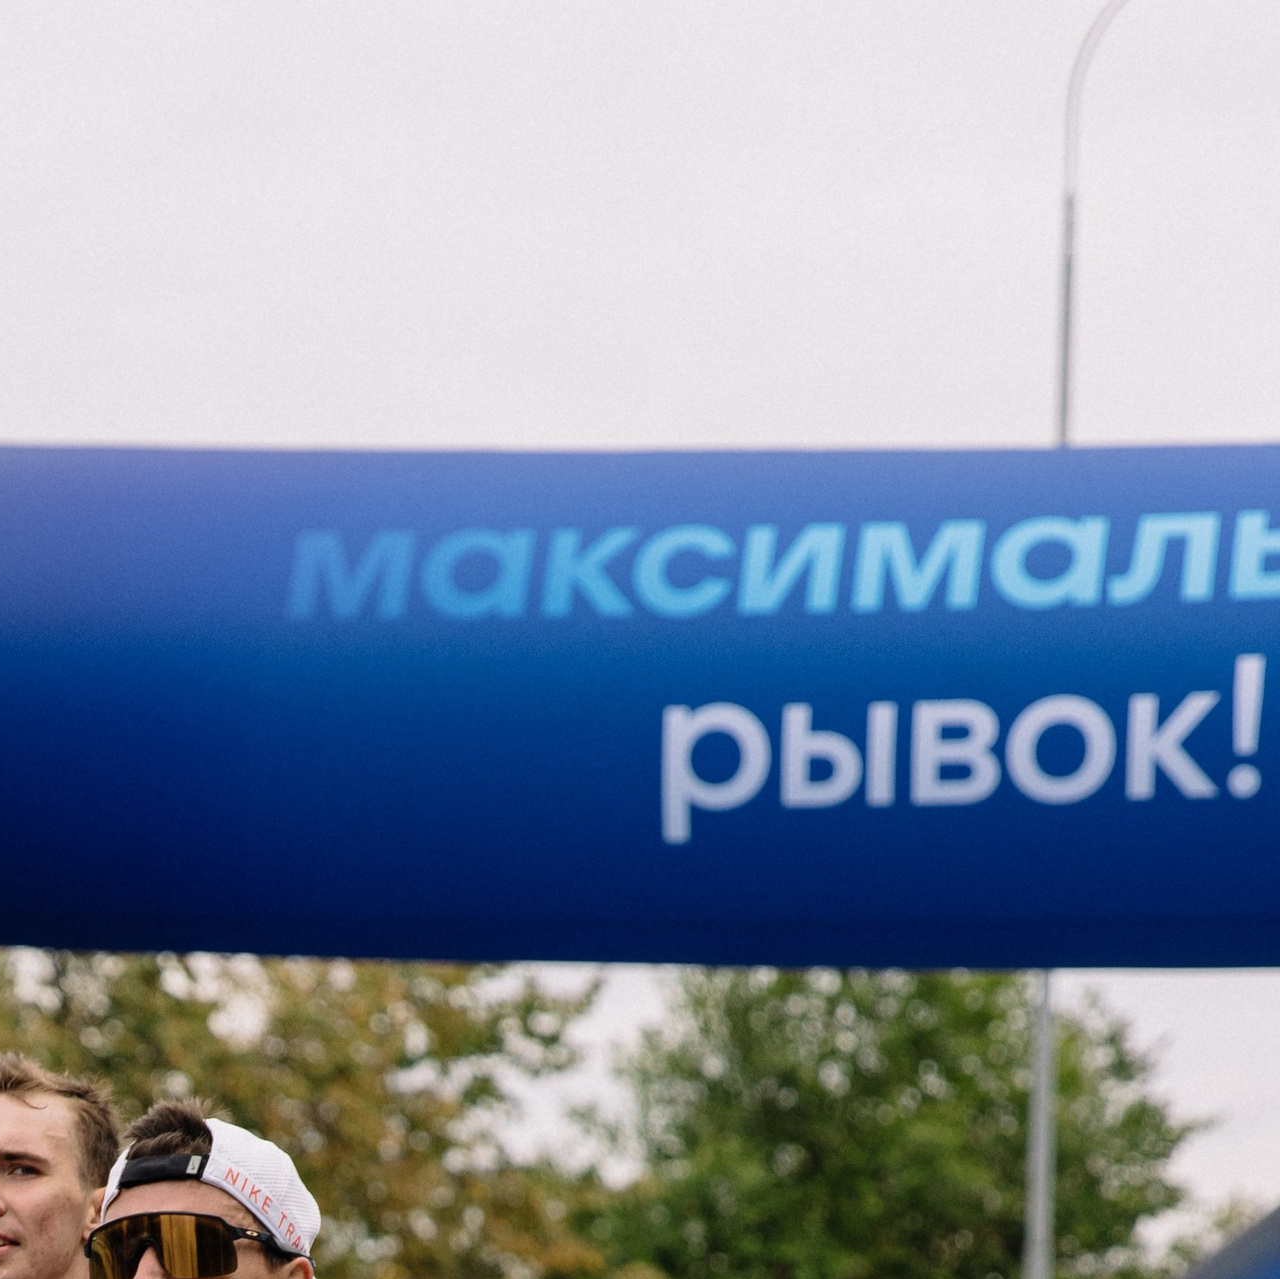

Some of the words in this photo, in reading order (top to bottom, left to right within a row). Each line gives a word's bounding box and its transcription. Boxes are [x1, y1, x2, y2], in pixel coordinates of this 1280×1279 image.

[661, 652, 1267, 845] рывок!
[223, 1167, 273, 1215] NIKE
[278, 1211, 307, 1253] TRAI
